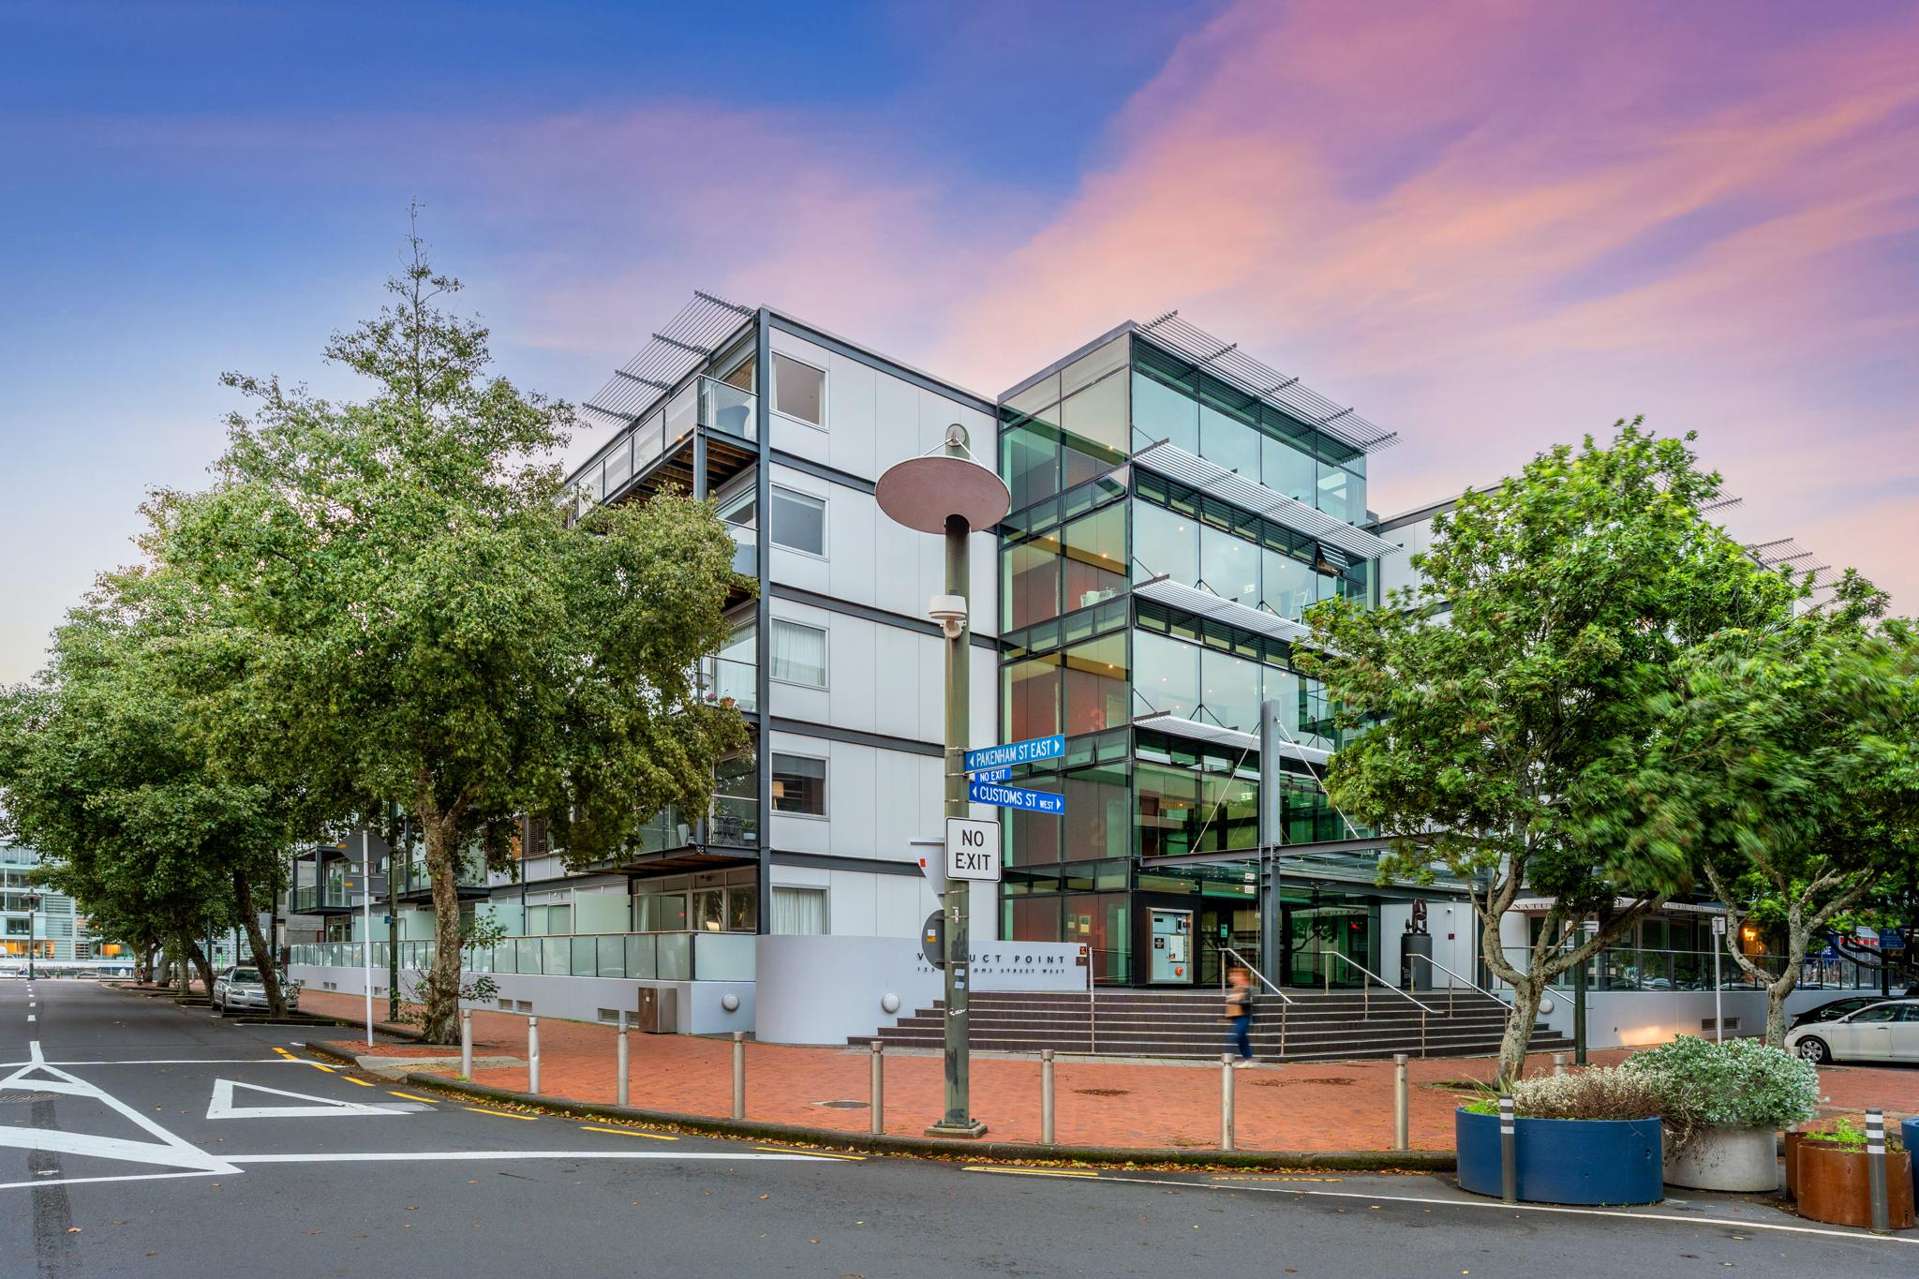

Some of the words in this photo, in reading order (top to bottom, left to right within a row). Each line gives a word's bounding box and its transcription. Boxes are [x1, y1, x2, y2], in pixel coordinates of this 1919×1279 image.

[976, 746, 1017, 767] PAKENHAM
[1018, 744, 1029, 760] ST
[1030, 740, 1051, 758] EAST
[980, 772, 989, 783] NO
[991, 769, 1006, 781] EXIT
[979, 786, 1023, 806] CUSTOMS
[1025, 794, 1037, 807] ST
[1039, 799, 1054, 810] WEST
[962, 829, 984, 847] NO
[955, 852, 991, 871] EXIT
[917, 952, 1002, 963] VUCT
[1014, 954, 1065, 964] POINT
